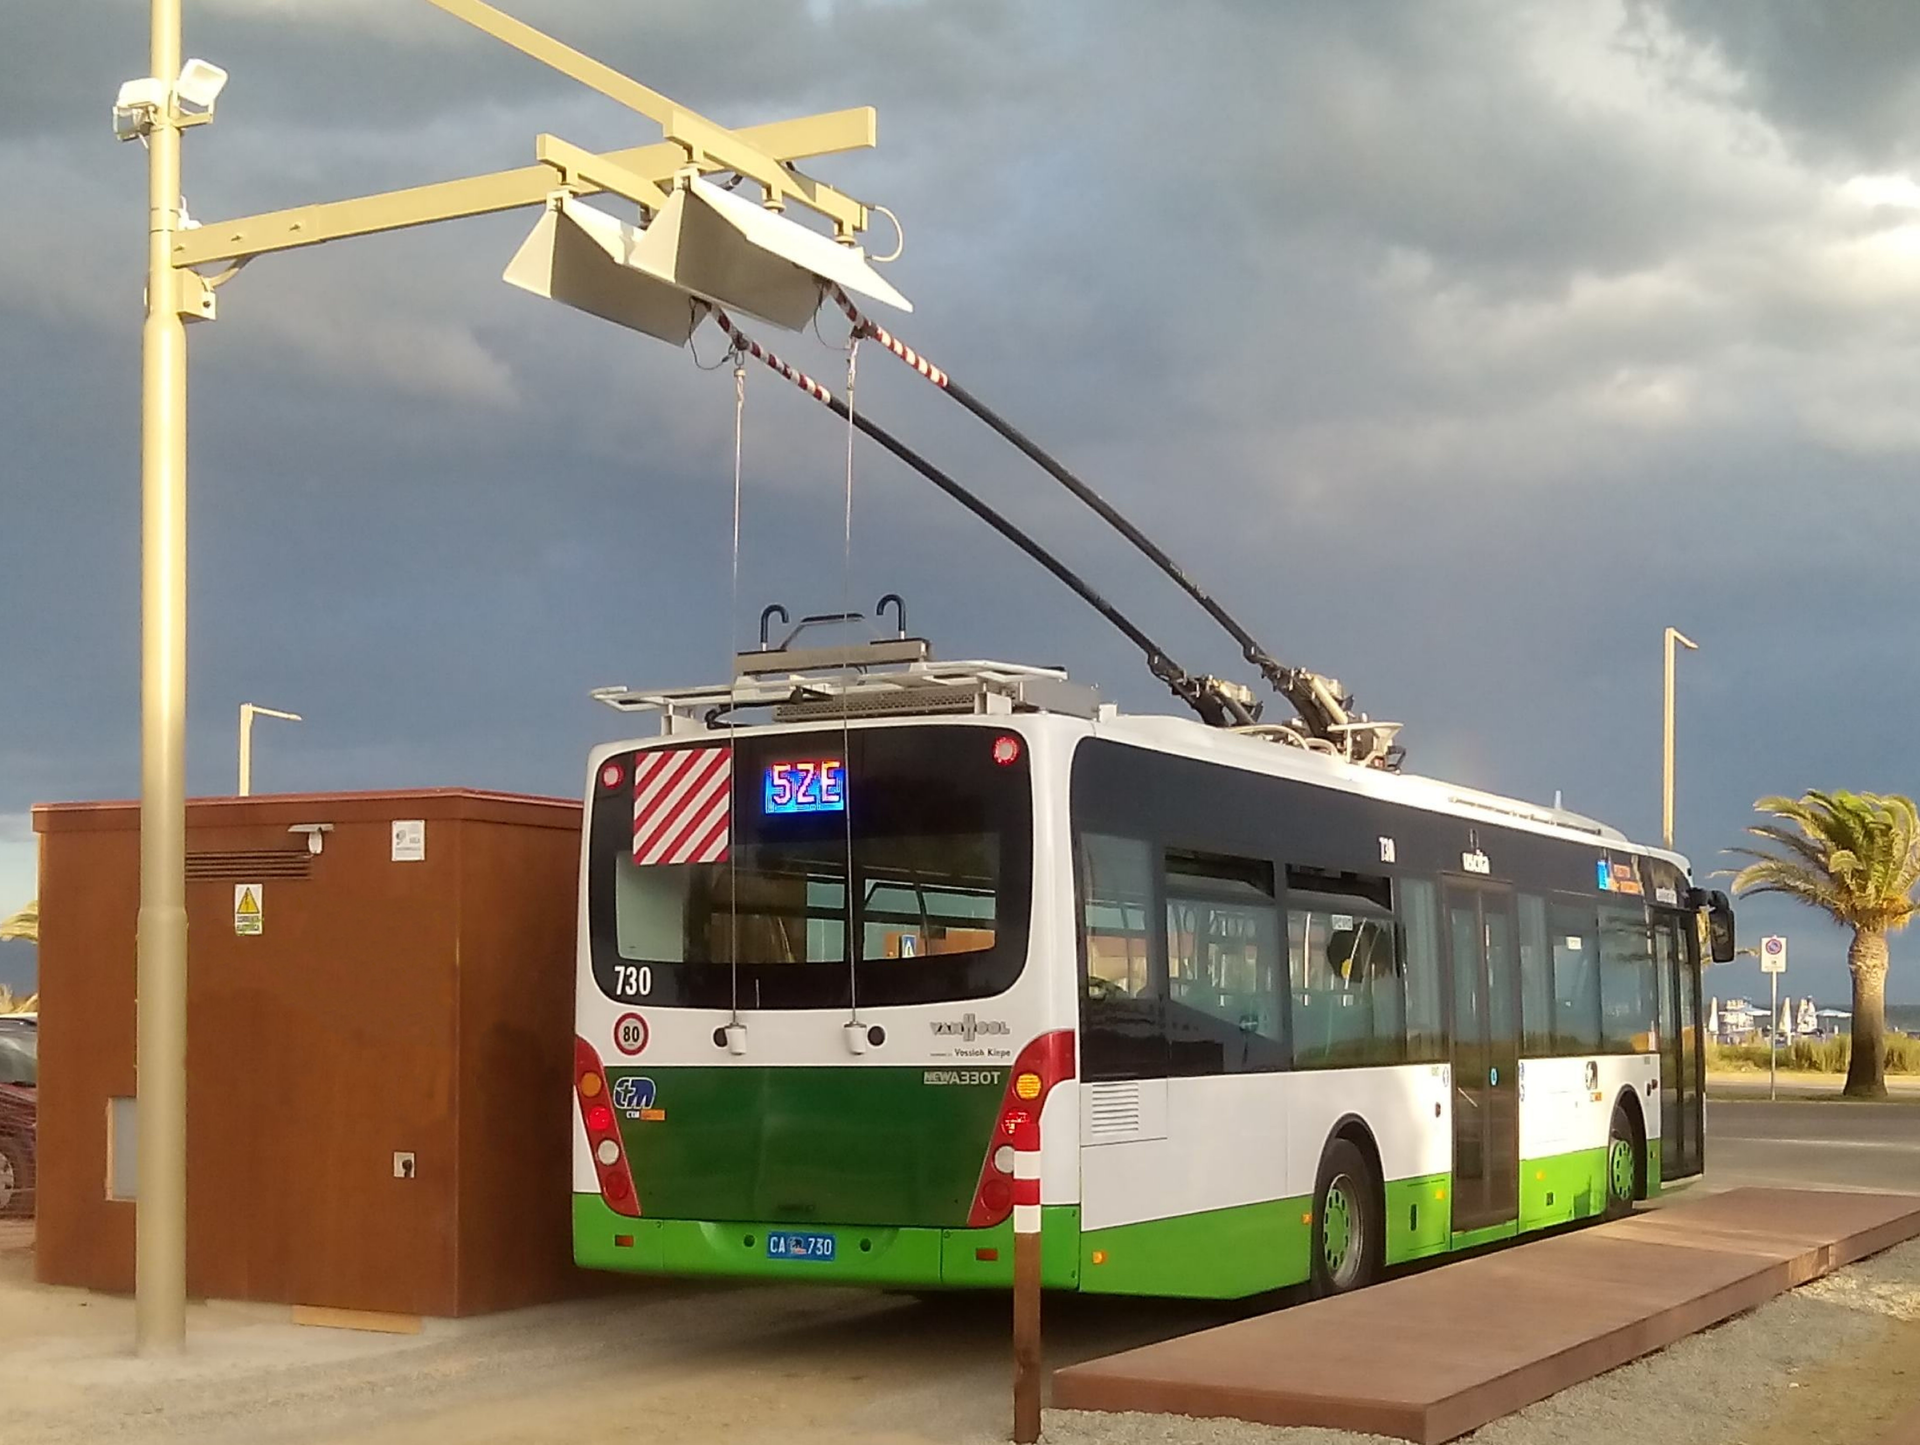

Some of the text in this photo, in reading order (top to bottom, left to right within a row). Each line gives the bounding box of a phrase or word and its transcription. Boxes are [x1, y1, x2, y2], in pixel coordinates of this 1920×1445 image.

[614, 966, 652, 996] 730
[623, 1025, 640, 1043] 80
[770, 1236, 833, 1256] CA 730
